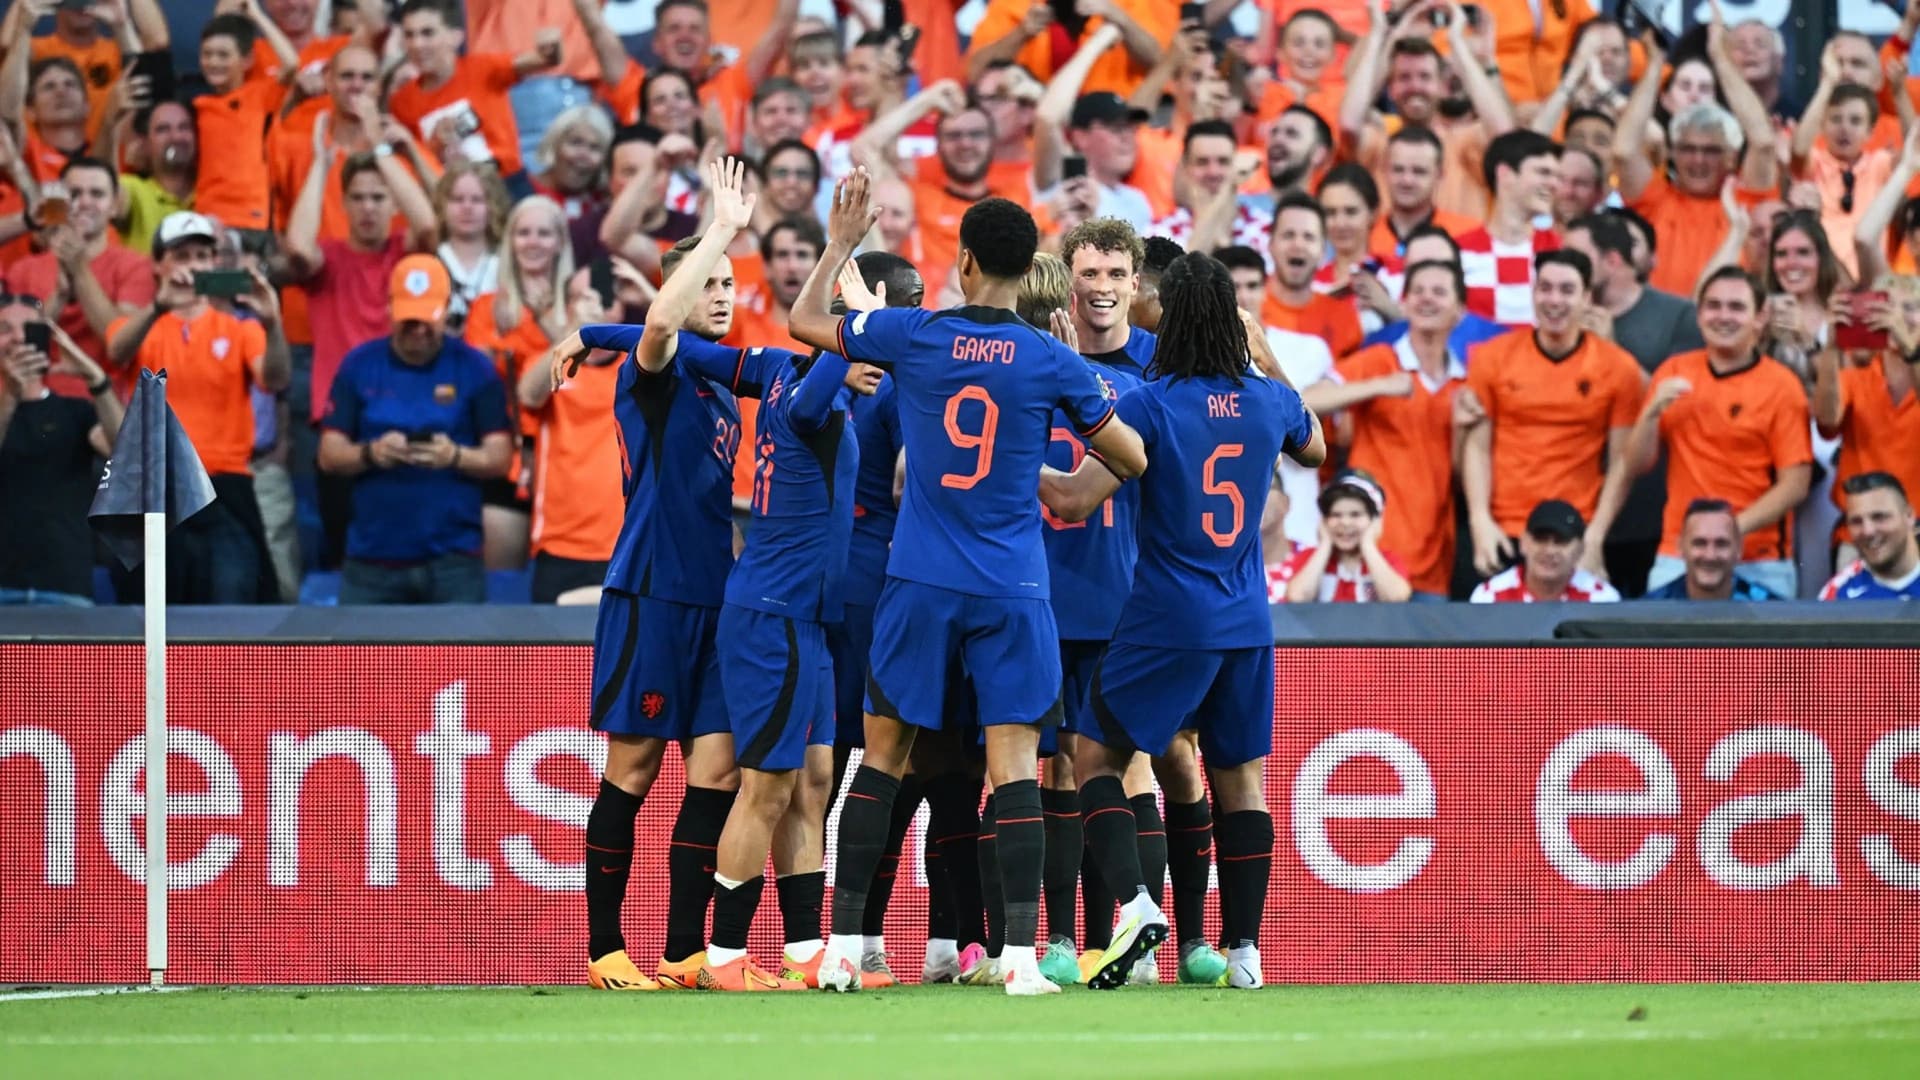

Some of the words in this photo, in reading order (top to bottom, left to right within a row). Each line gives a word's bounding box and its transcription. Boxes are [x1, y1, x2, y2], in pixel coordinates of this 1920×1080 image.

[952, 335, 1016, 364] GAKPO
[940, 384, 1000, 490] 9
[1202, 443, 1245, 548] 5
